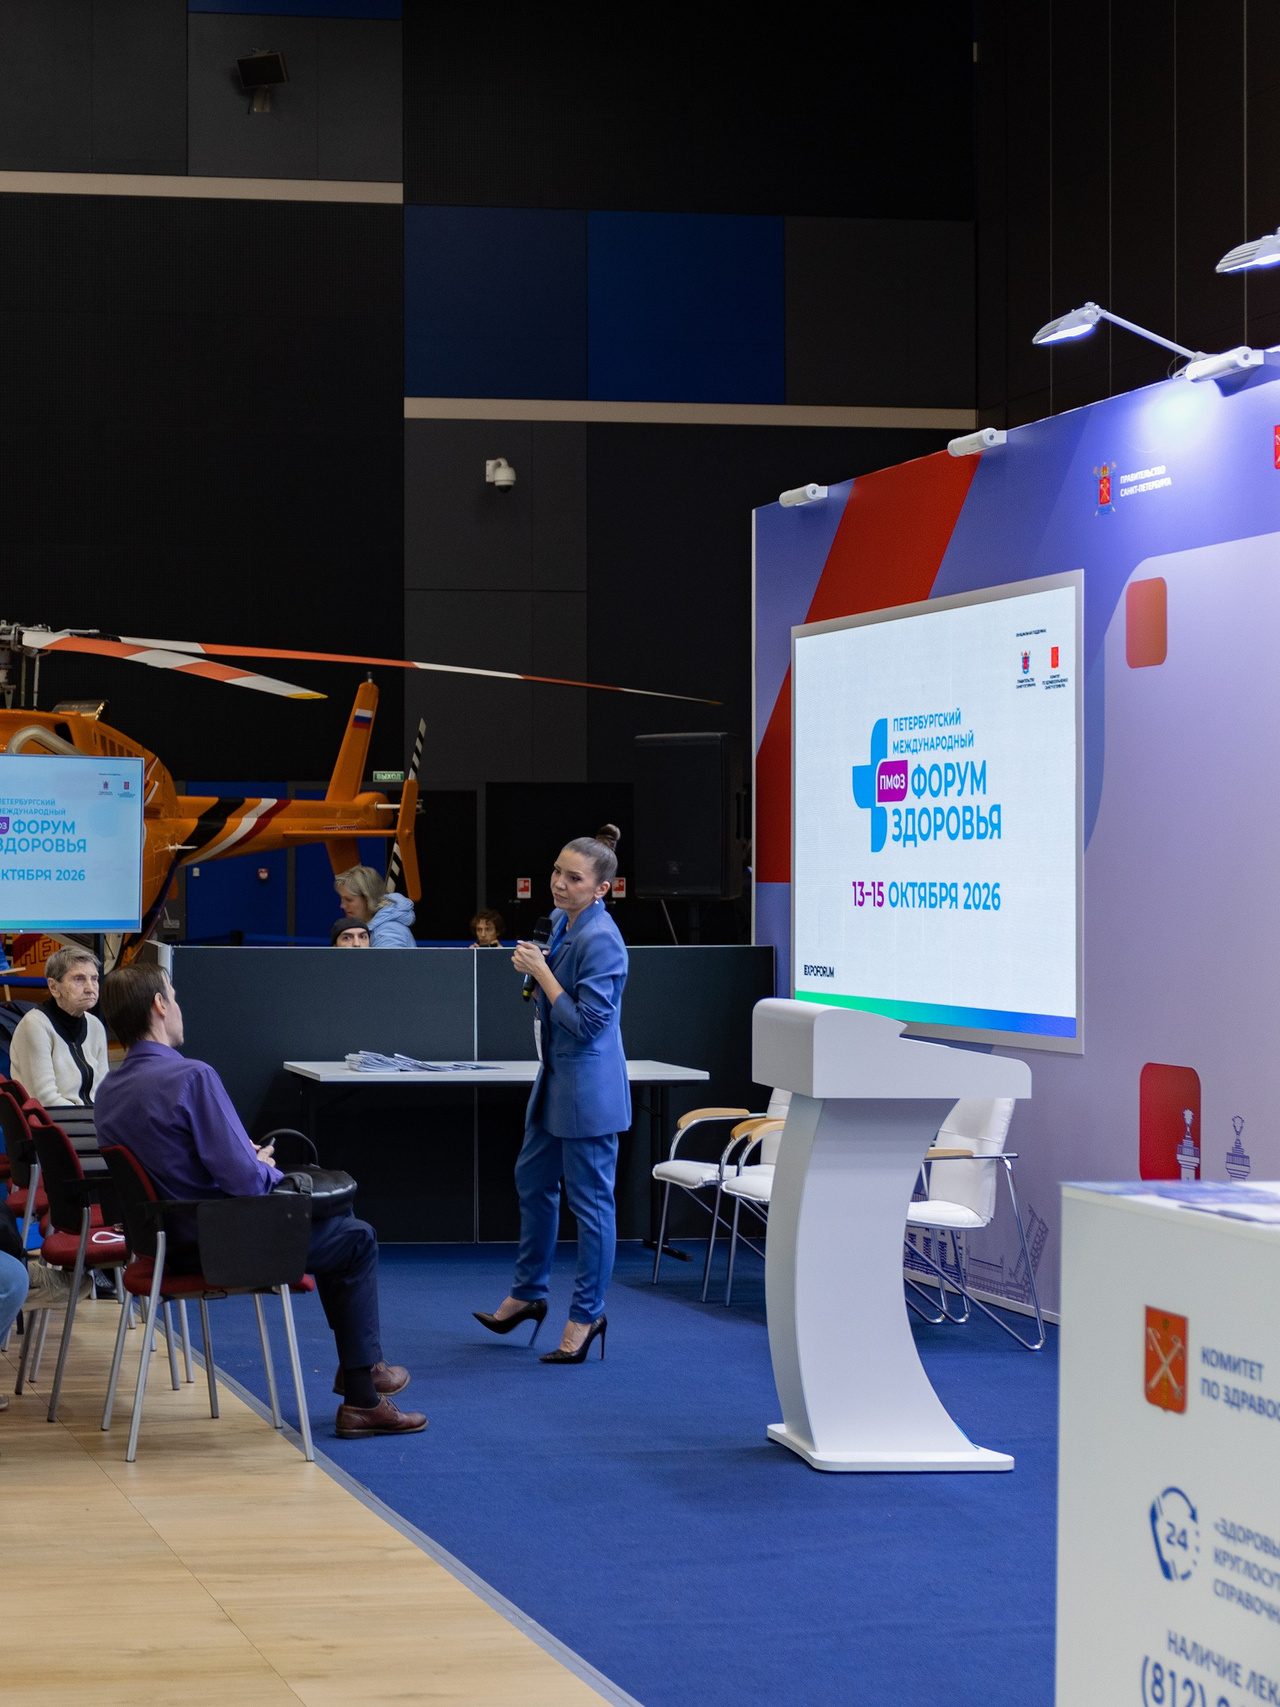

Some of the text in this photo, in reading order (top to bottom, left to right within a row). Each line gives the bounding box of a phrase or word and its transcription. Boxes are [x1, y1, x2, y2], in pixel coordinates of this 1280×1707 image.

[893, 707, 961, 732] ПЕТЕРБУРГСКИЙ
[892, 730, 974, 755] МЕЖДУНАРОДНЫЙ
[880, 773, 906, 790] ПМФЗ
[911, 760, 986, 799] ФОРУМ
[12, 819, 76, 835] ФОРУМ
[891, 804, 1001, 848] ЗДОРОВЬЯ
[55, 869, 86, 881] 2026
[888, 881, 958, 909] ОКТЯБРЯ
[963, 882, 1001, 911] 2026
[1202, 1346, 1264, 1382] КОМИТЕТ
[1202, 1377, 1220, 1400] ПО
[1166, 1521, 1188, 1551] 24
[1167, 1628, 1241, 1689] НАЛИЧИЕ
